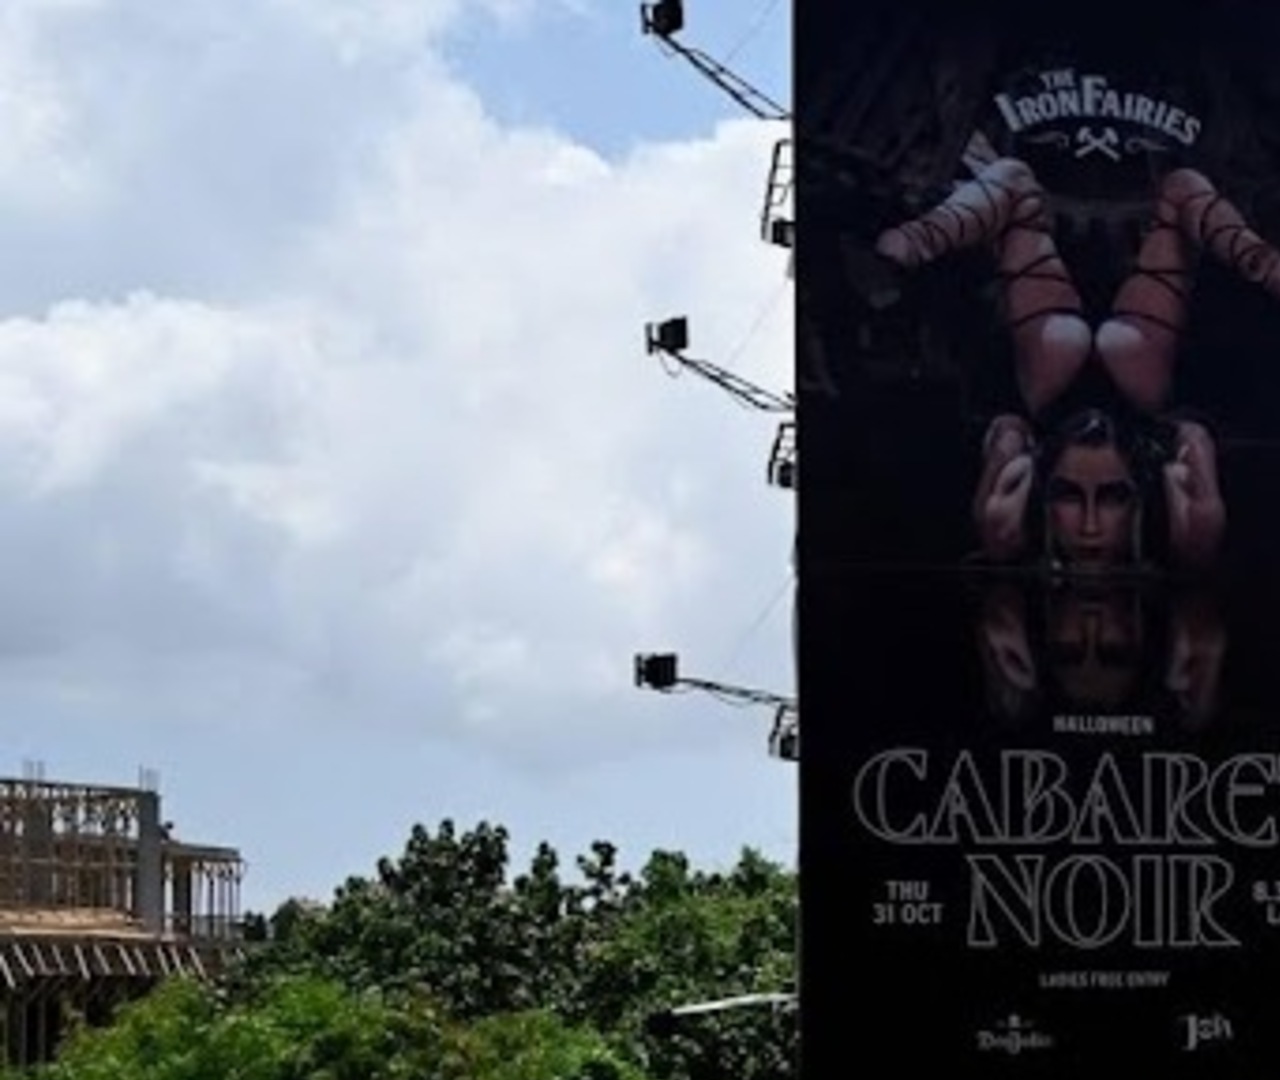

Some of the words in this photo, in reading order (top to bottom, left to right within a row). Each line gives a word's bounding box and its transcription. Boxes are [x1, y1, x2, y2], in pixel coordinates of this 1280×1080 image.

[1053, 715, 1153, 734] HALLOWEEN
[887, 881, 928, 901] THU
[967, 854, 1241, 947] NOIR
[873, 904, 896, 924] 31
[902, 904, 942, 924] OCT
